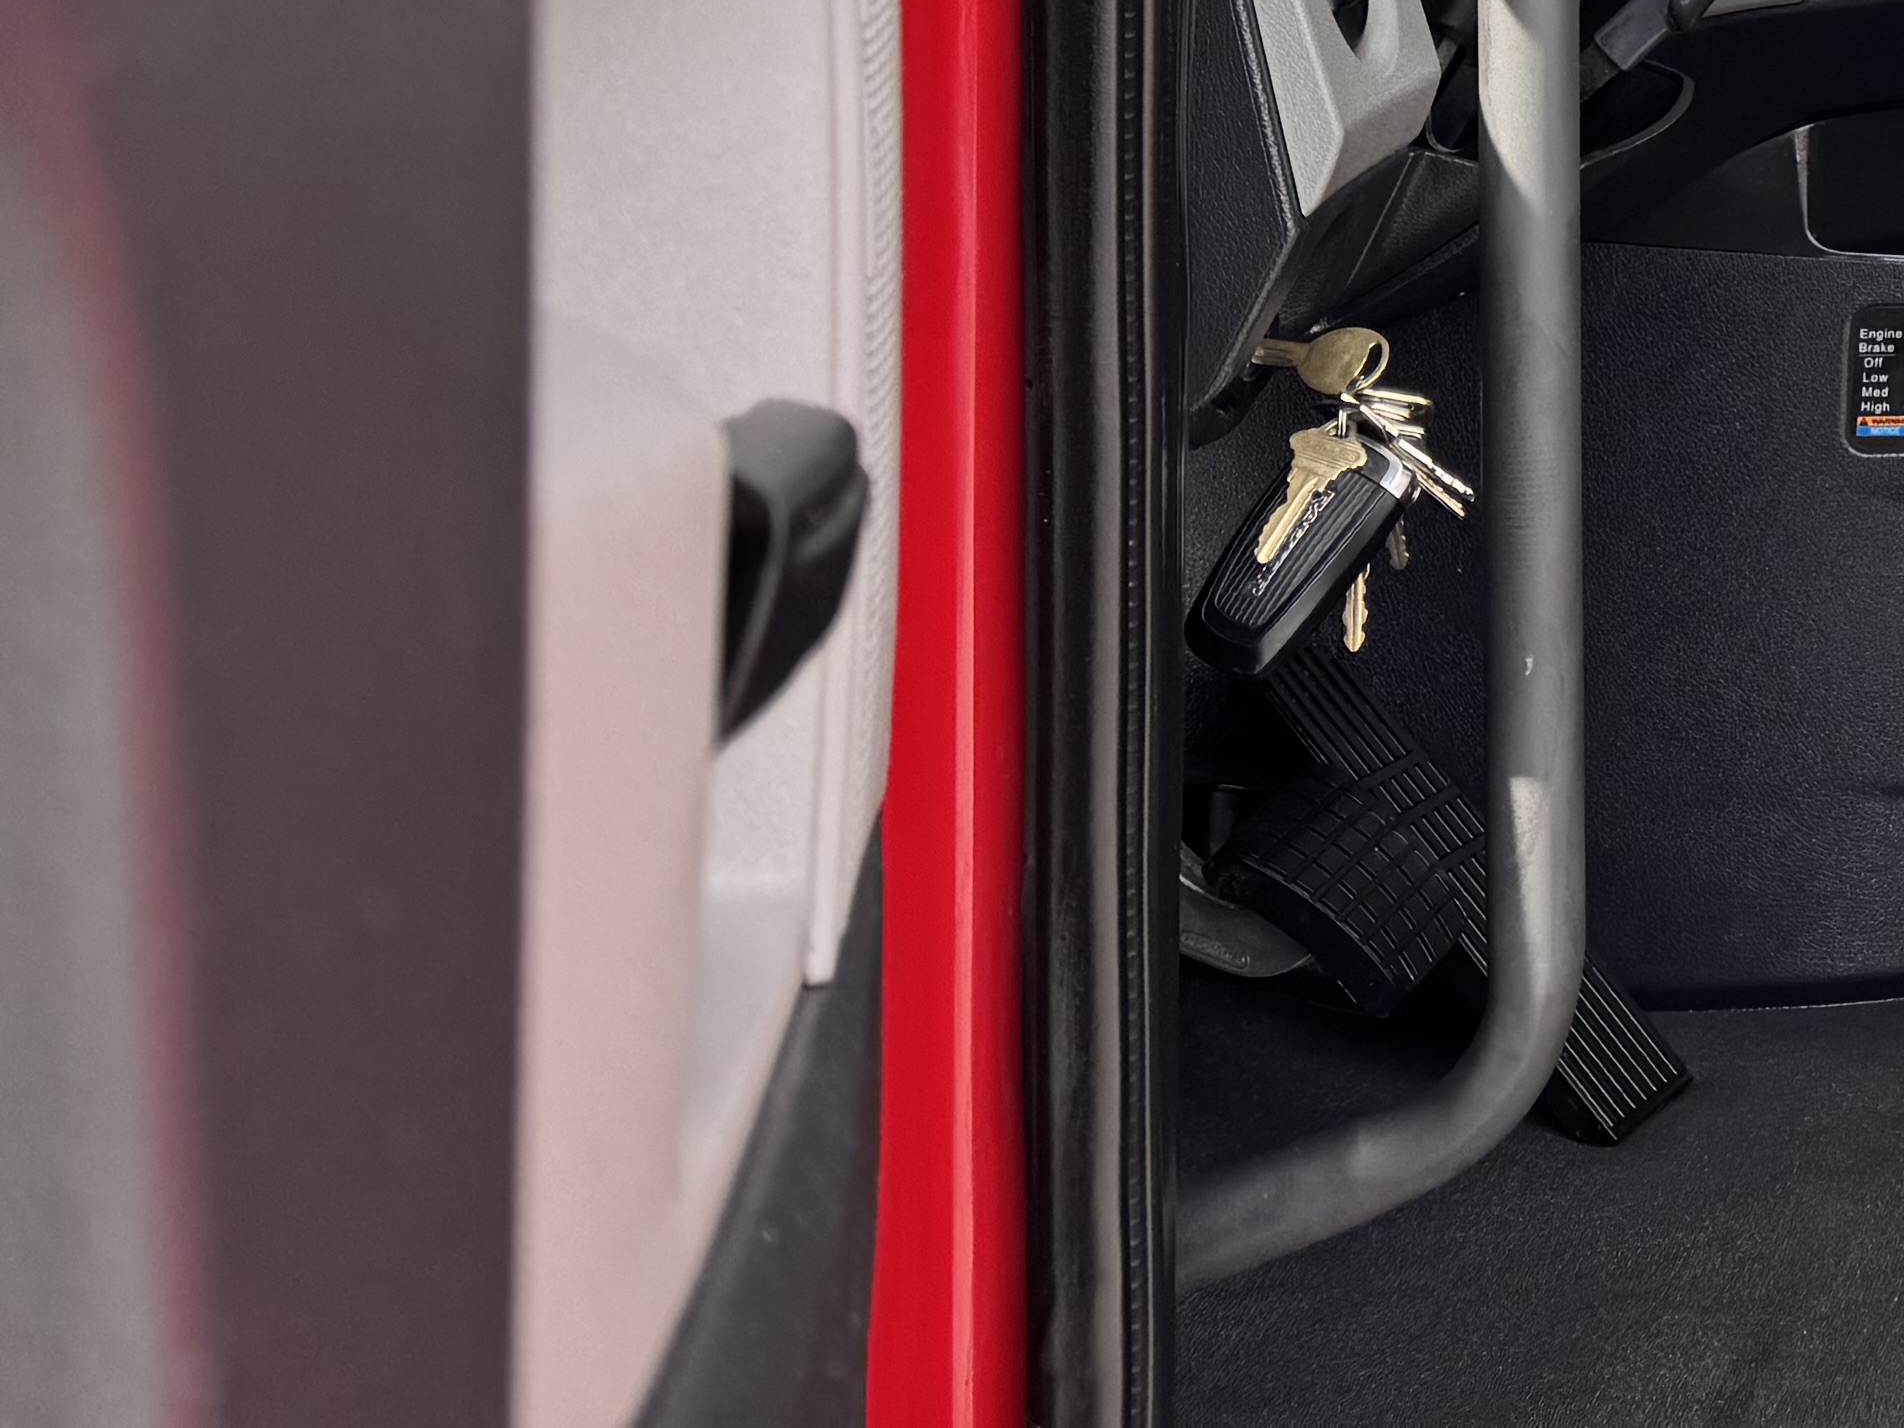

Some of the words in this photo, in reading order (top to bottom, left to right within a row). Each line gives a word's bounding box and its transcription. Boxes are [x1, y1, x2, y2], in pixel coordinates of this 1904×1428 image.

[1860, 328, 1902, 341] Engine
[1858, 342, 1894, 353] Brake
[1864, 357, 1883, 368] Off
[1862, 372, 1888, 383] Low
[1862, 387, 1889, 397] Med
[1861, 402, 1890, 414] High
